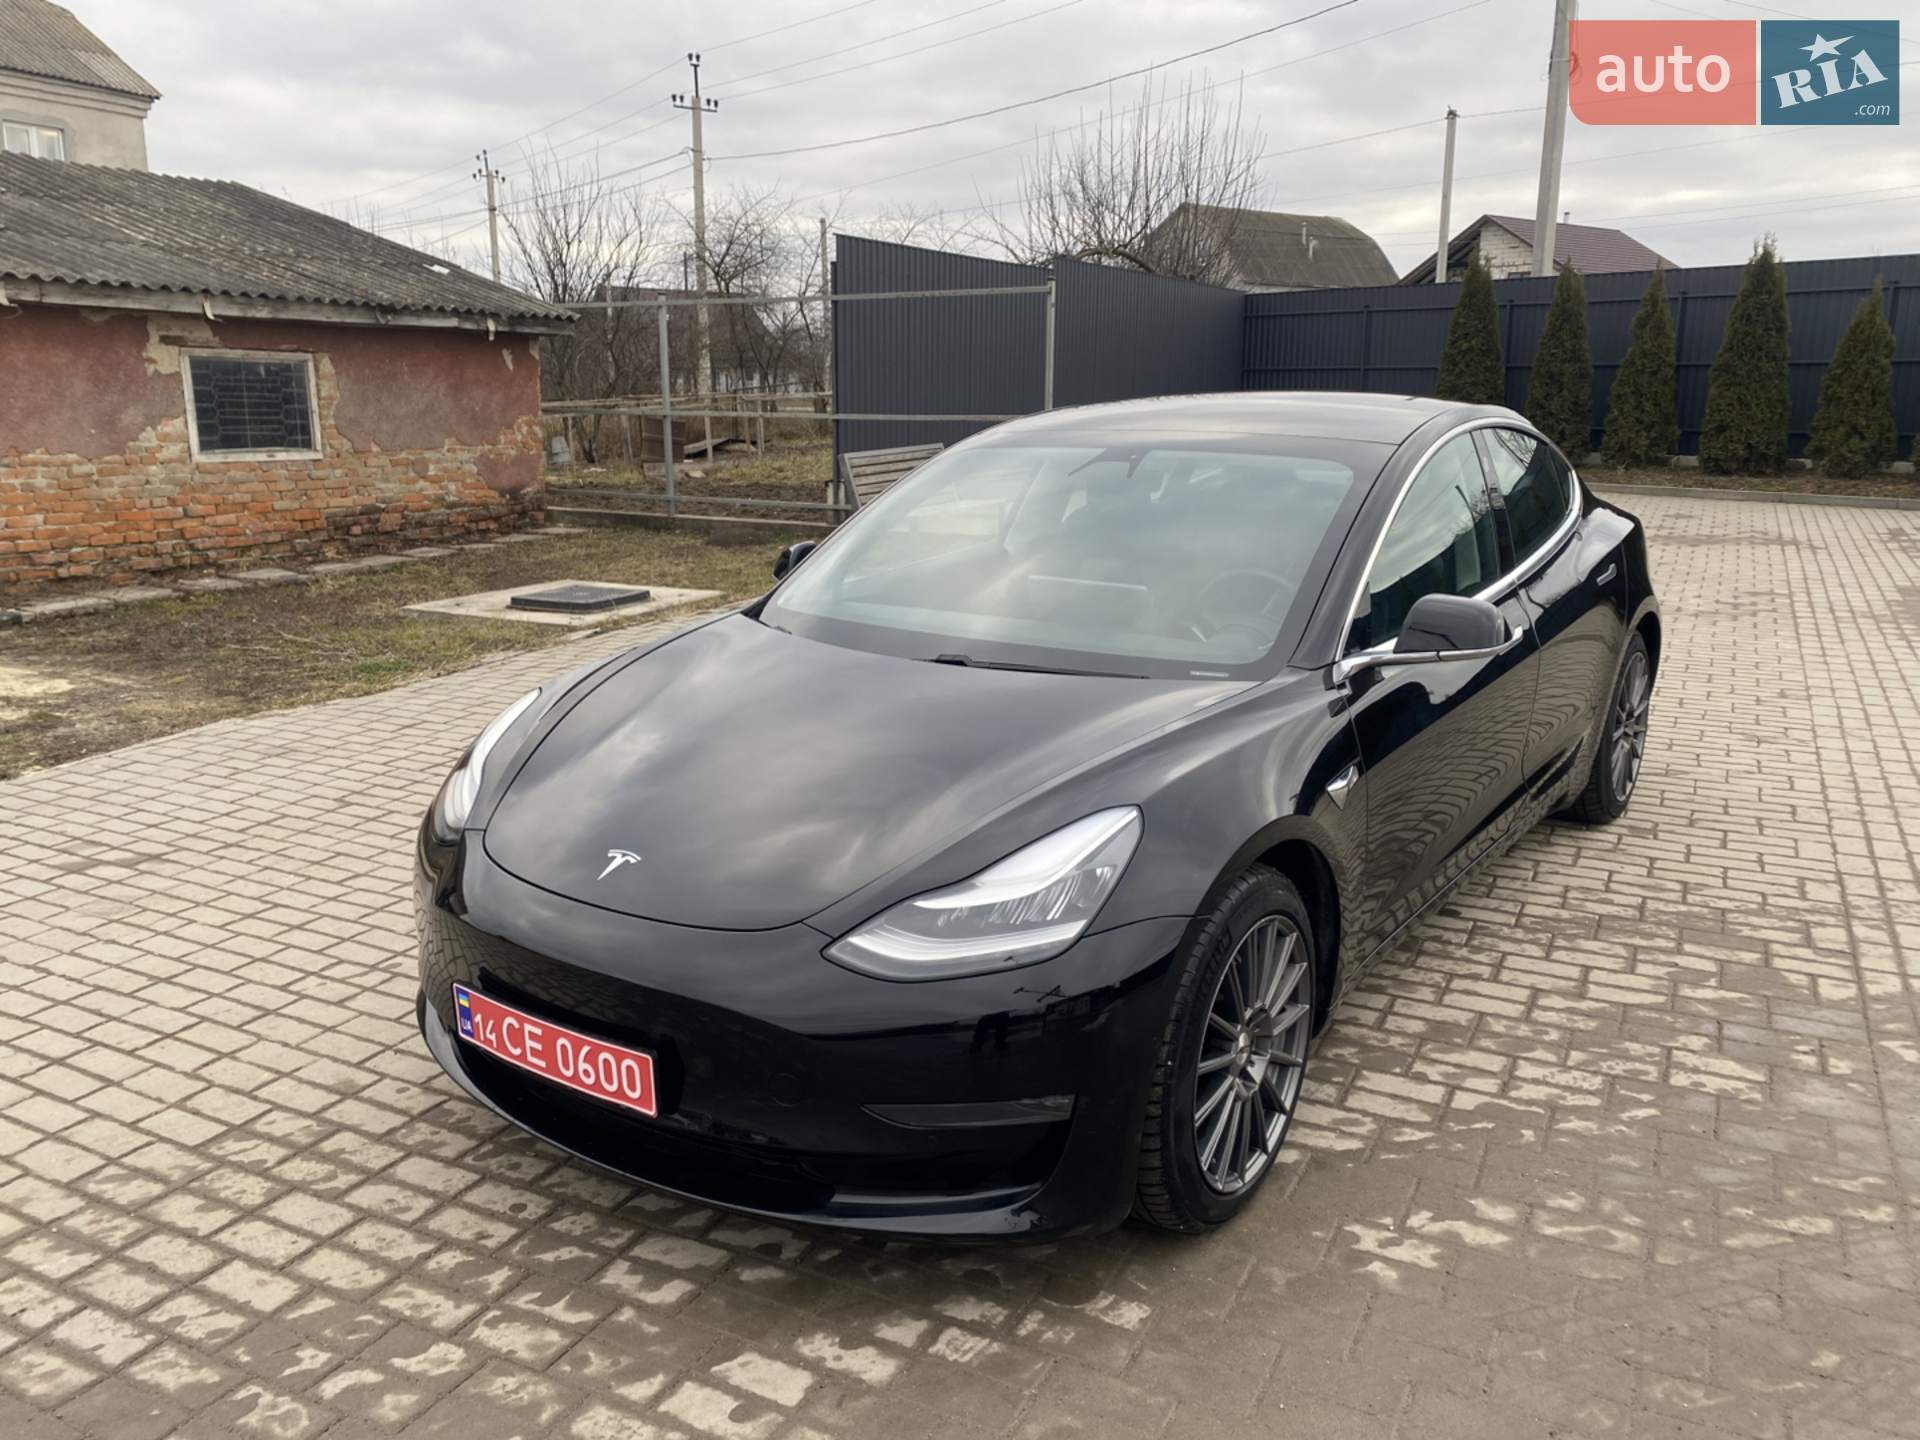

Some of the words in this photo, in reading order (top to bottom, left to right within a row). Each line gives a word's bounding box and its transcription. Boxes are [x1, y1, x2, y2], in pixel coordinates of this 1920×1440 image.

[461, 1018, 473, 1033] UA
[474, 1013, 497, 1048] 14
[556, 1037, 642, 1099] 0600
